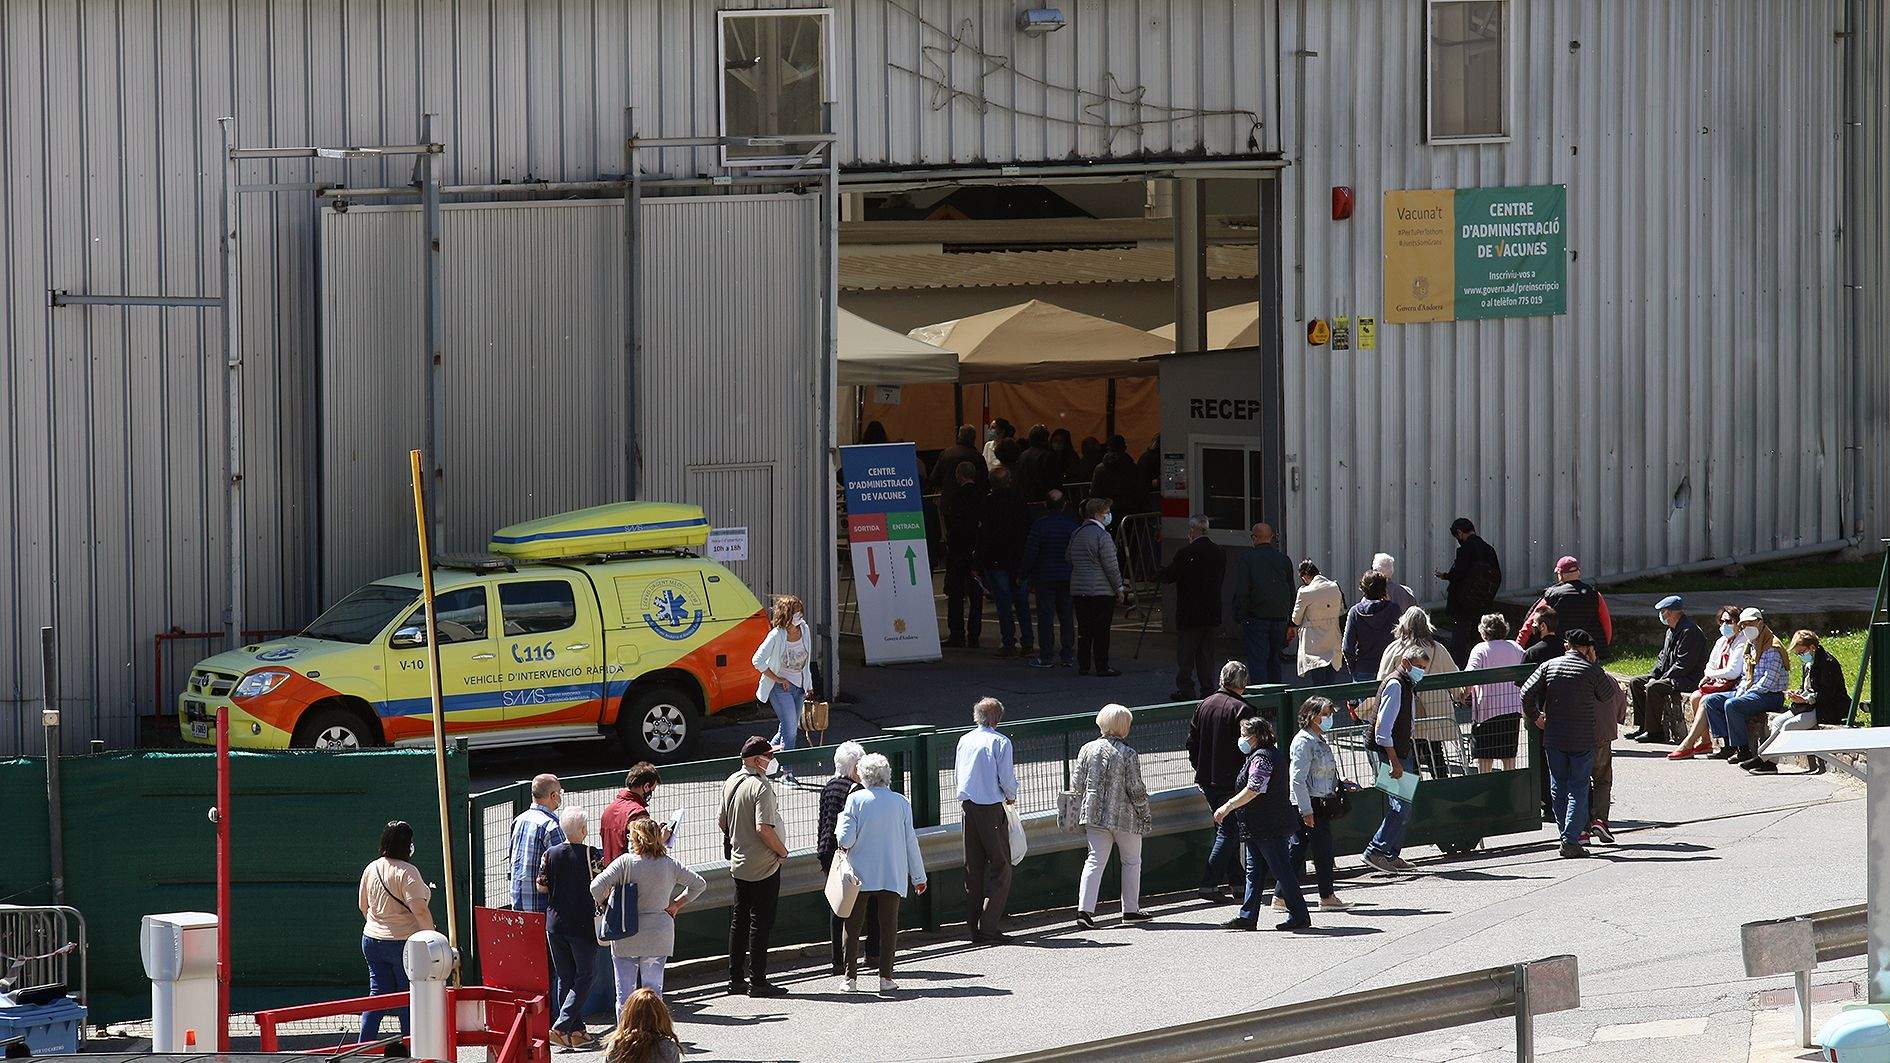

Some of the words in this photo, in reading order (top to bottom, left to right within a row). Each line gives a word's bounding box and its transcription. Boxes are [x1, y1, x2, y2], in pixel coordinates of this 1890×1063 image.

[1397, 206, 1442, 220] Vacuna't
[1489, 202, 1534, 217] CENTRE
[1462, 216, 1560, 238] D'ADMINISTRACIÓ
[1477, 244, 1493, 258] DE
[1495, 240, 1548, 257] VACUNES
[1489, 270, 1531, 280] Inscriviu-vos
[1481, 300, 1486, 308] o
[1487, 298, 1493, 307] al
[1518, 296, 1529, 305] 775
[1531, 296, 1543, 304] 019
[885, 393, 890, 401] 7
[868, 467, 896, 476] CENTRE
[848, 477, 914, 490] D'ADMINISTRACIÓ
[861, 493, 872, 501] DE
[872, 491, 907, 501] VACUNES
[524, 641, 556, 662] 116
[399, 659, 424, 671] V-10
[463, 673, 503, 685] VEHICLE
[508, 665, 582, 682] D'INTERVENCIÓ
[586, 664, 625, 675] RÀPIDA
